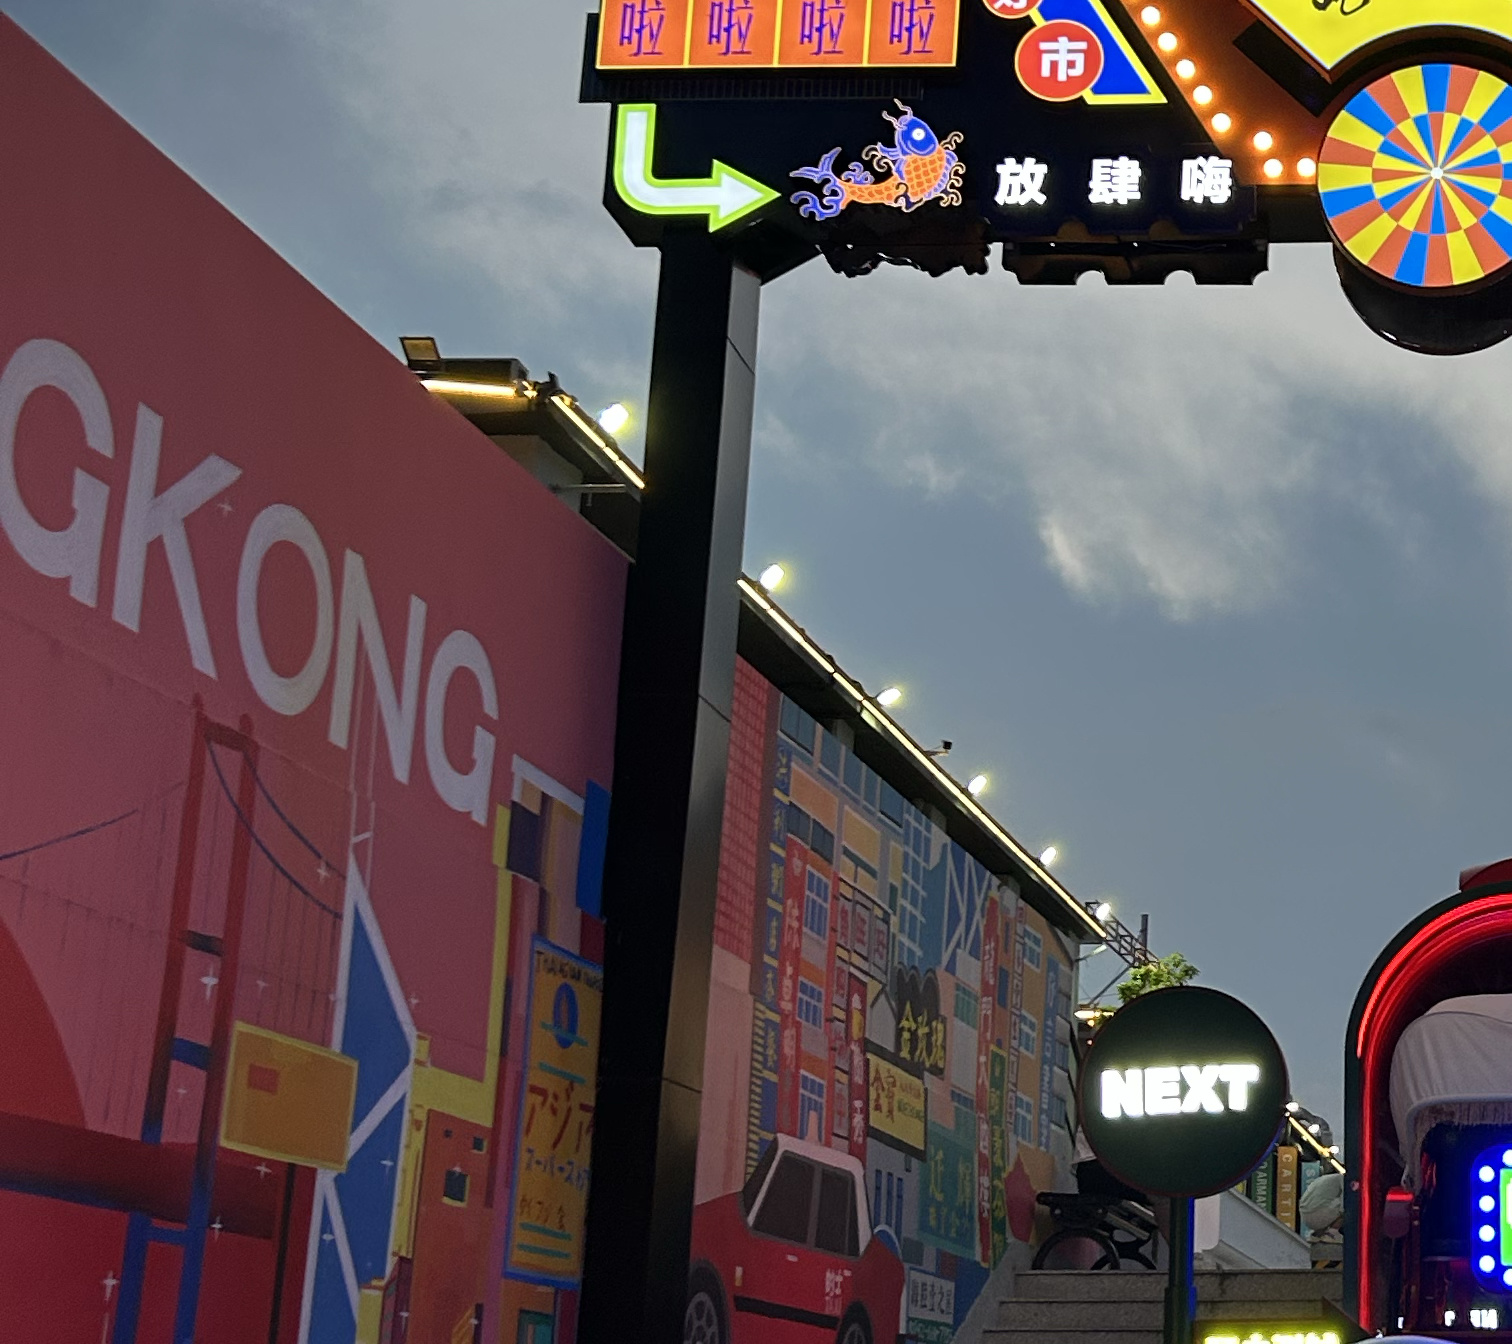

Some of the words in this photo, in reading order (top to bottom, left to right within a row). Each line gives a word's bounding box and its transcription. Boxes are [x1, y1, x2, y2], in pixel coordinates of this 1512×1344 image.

[996, 157, 1233, 205] 放肆嗨
[1100, 1064, 1259, 1118] NEXT
